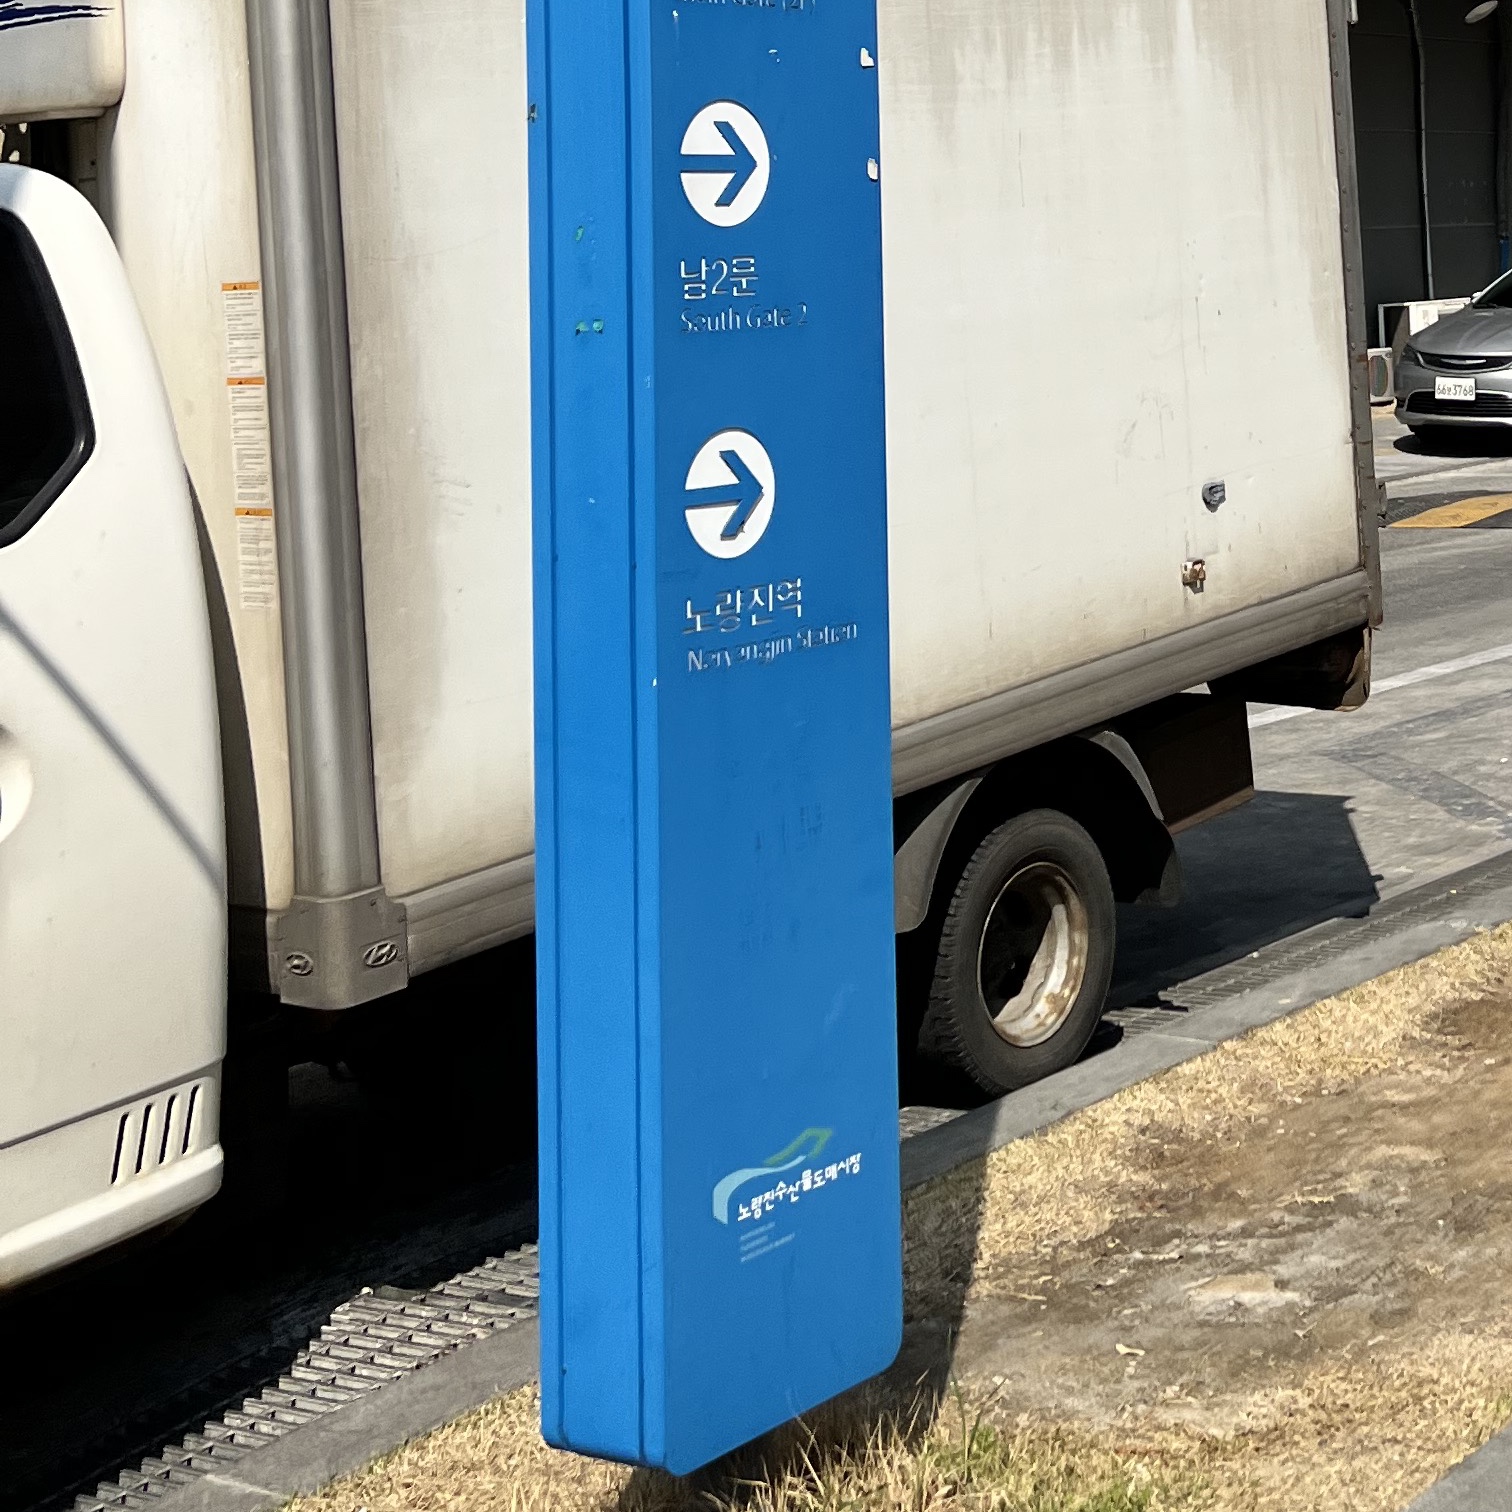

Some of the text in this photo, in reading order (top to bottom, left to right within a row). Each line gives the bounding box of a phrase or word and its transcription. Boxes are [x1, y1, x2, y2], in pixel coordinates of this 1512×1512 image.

[680, 256, 759, 300] 남2문
[680, 304, 741, 334] South
[746, 303, 792, 330] Gate
[682, 577, 803, 635] 노량진역
